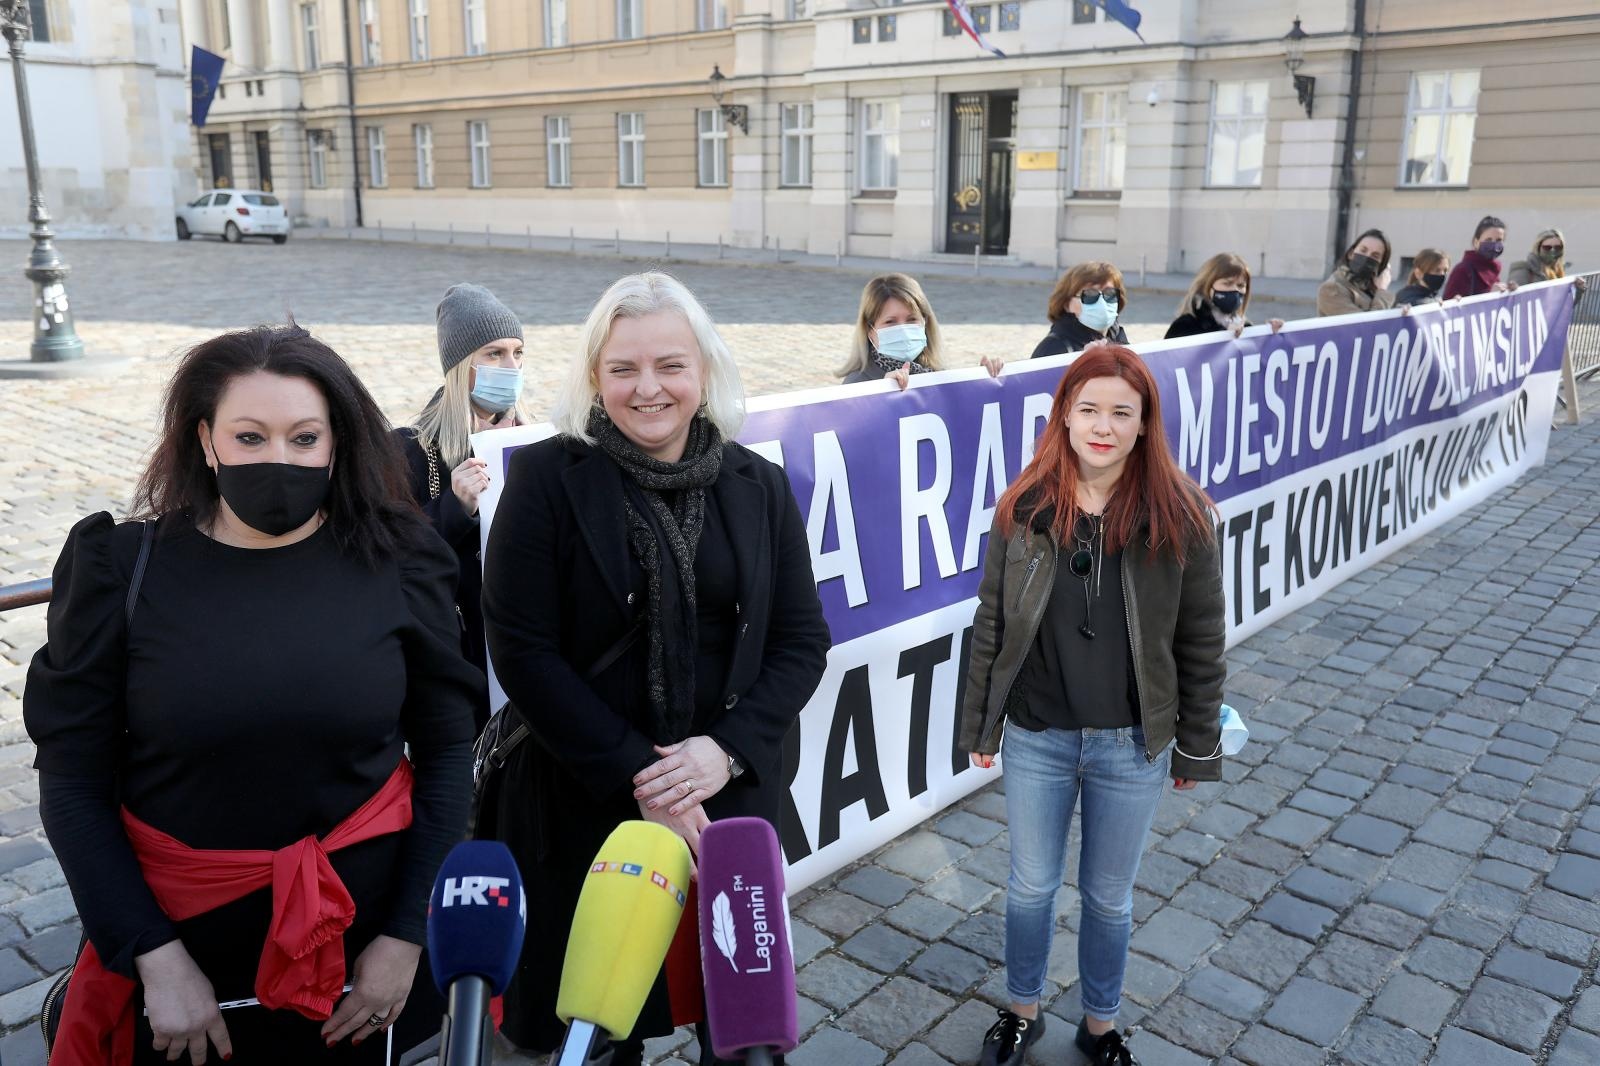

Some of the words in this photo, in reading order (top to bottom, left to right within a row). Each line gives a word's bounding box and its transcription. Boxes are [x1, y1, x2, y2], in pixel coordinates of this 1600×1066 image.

[1175, 340, 1339, 489] MJESTO
[1342, 337, 1362, 440] I
[1362, 328, 1433, 434] DOM
[1429, 317, 1471, 411] BEZ
[1284, 424, 1471, 597] KONVENCIJU
[442, 875, 509, 908] HRT
[592, 862, 643, 876] RTL
[733, 875, 743, 891] FM
[746, 886, 775, 973] Laganini
